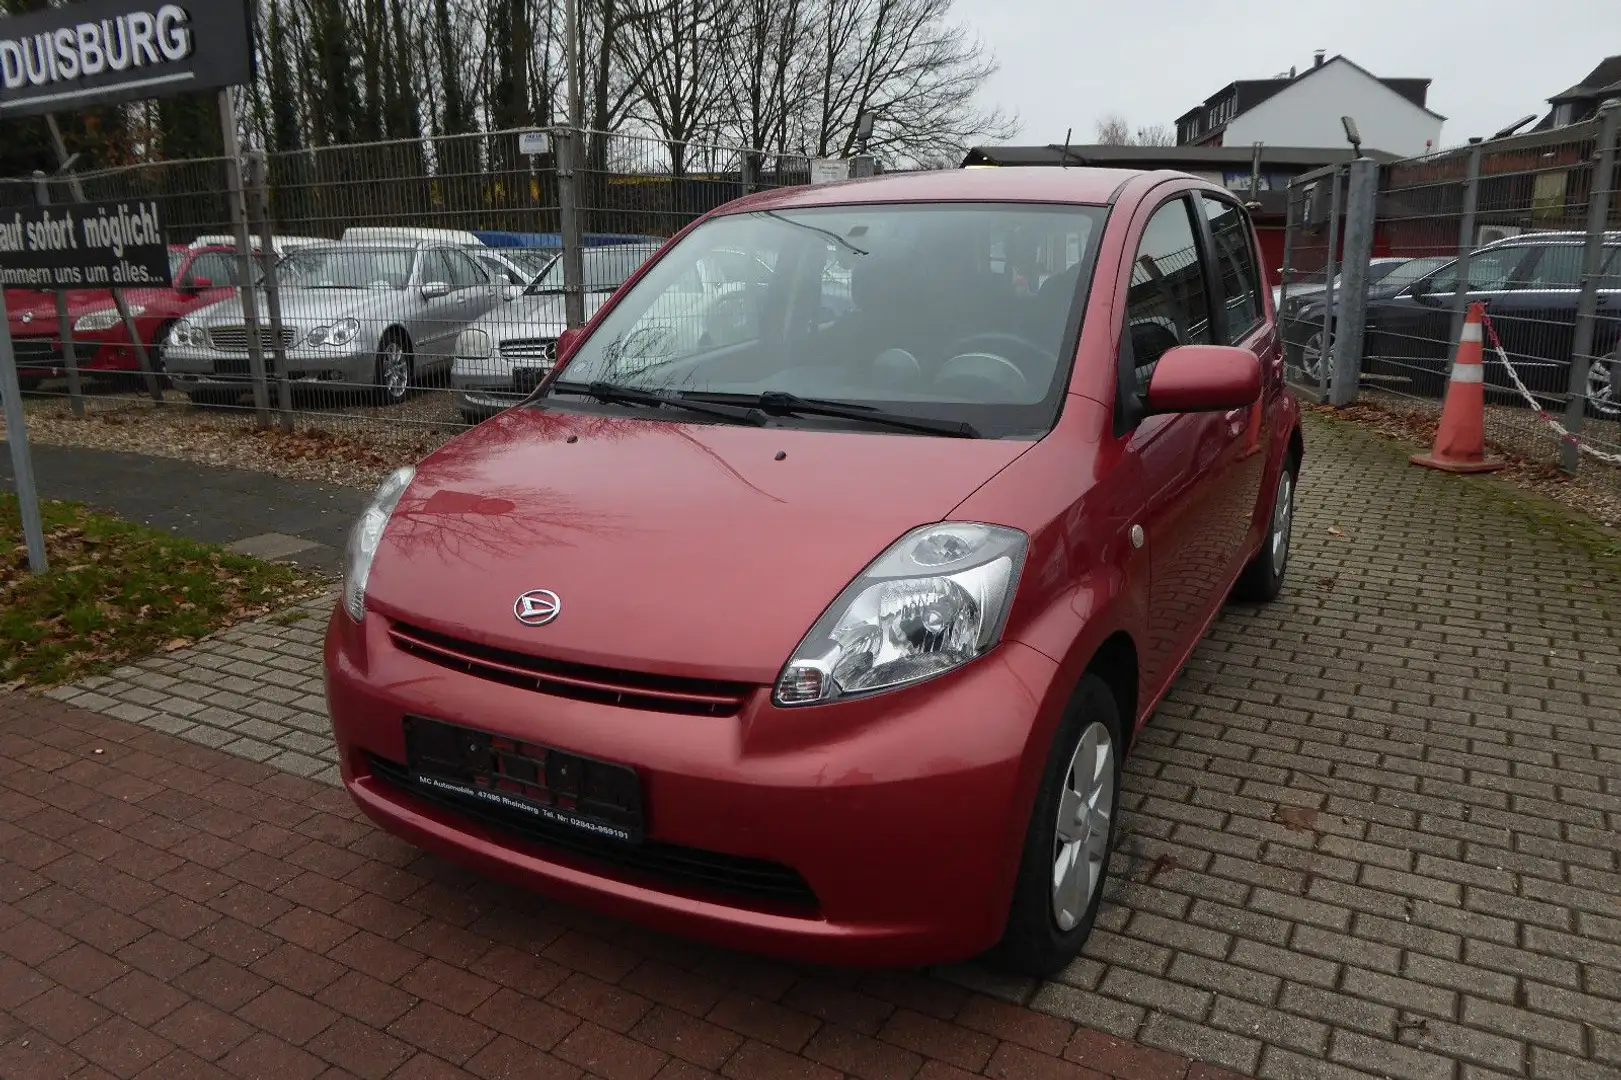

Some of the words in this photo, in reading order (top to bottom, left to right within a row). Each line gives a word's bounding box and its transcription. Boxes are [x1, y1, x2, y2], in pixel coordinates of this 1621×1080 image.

[0, 4, 191, 89] DUISBURG
[26, 209, 78, 252] sofort
[83, 201, 161, 258] möglich!
[54, 266, 82, 283] uns
[84, 264, 110, 283] um
[112, 259, 164, 283] alles...
[419, 775, 432, 785] MC
[502, 797, 539, 815] Rheinberg
